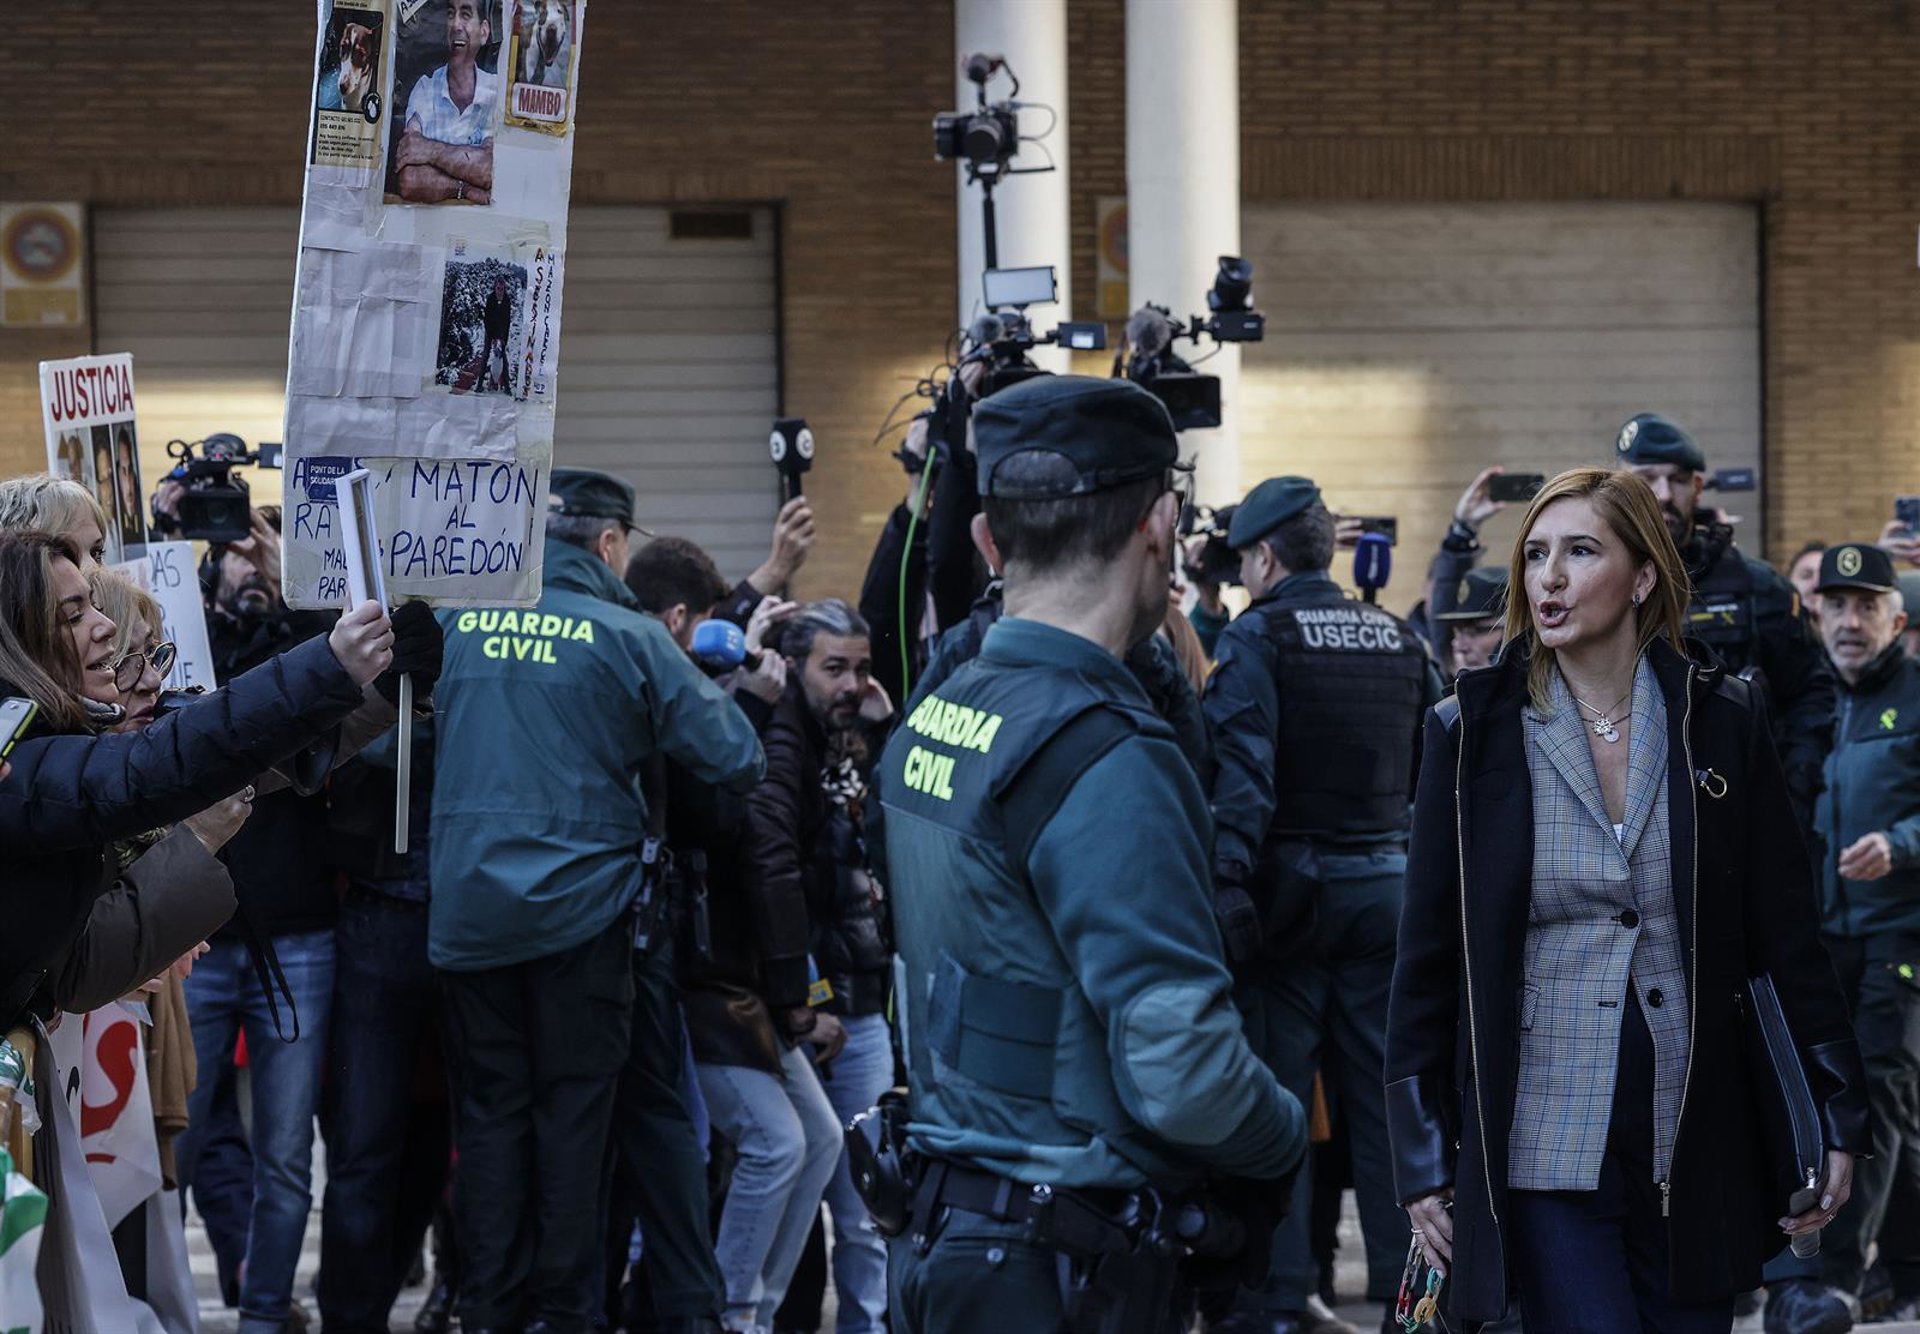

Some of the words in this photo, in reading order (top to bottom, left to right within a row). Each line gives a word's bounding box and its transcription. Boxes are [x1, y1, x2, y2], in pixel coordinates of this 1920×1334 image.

[518, 87, 562, 116] MAMBO
[50, 364, 134, 422] JUSTICIA
[310, 465, 328, 474] PONT
[328, 467, 336, 475] DE
[336, 467, 346, 475] LA
[310, 476, 336, 485] SOLIDAR
[446, 503, 476, 529] AL
[390, 527, 523, 579] PAREDÓN
[457, 611, 594, 644] GUARDIA
[1295, 609, 1362, 625] GUARDIA
[1360, 610, 1397, 629] CIVIL
[482, 636, 557, 664] CIVIL
[1302, 624, 1402, 650] USECIC
[903, 745, 956, 801] CIVIL
